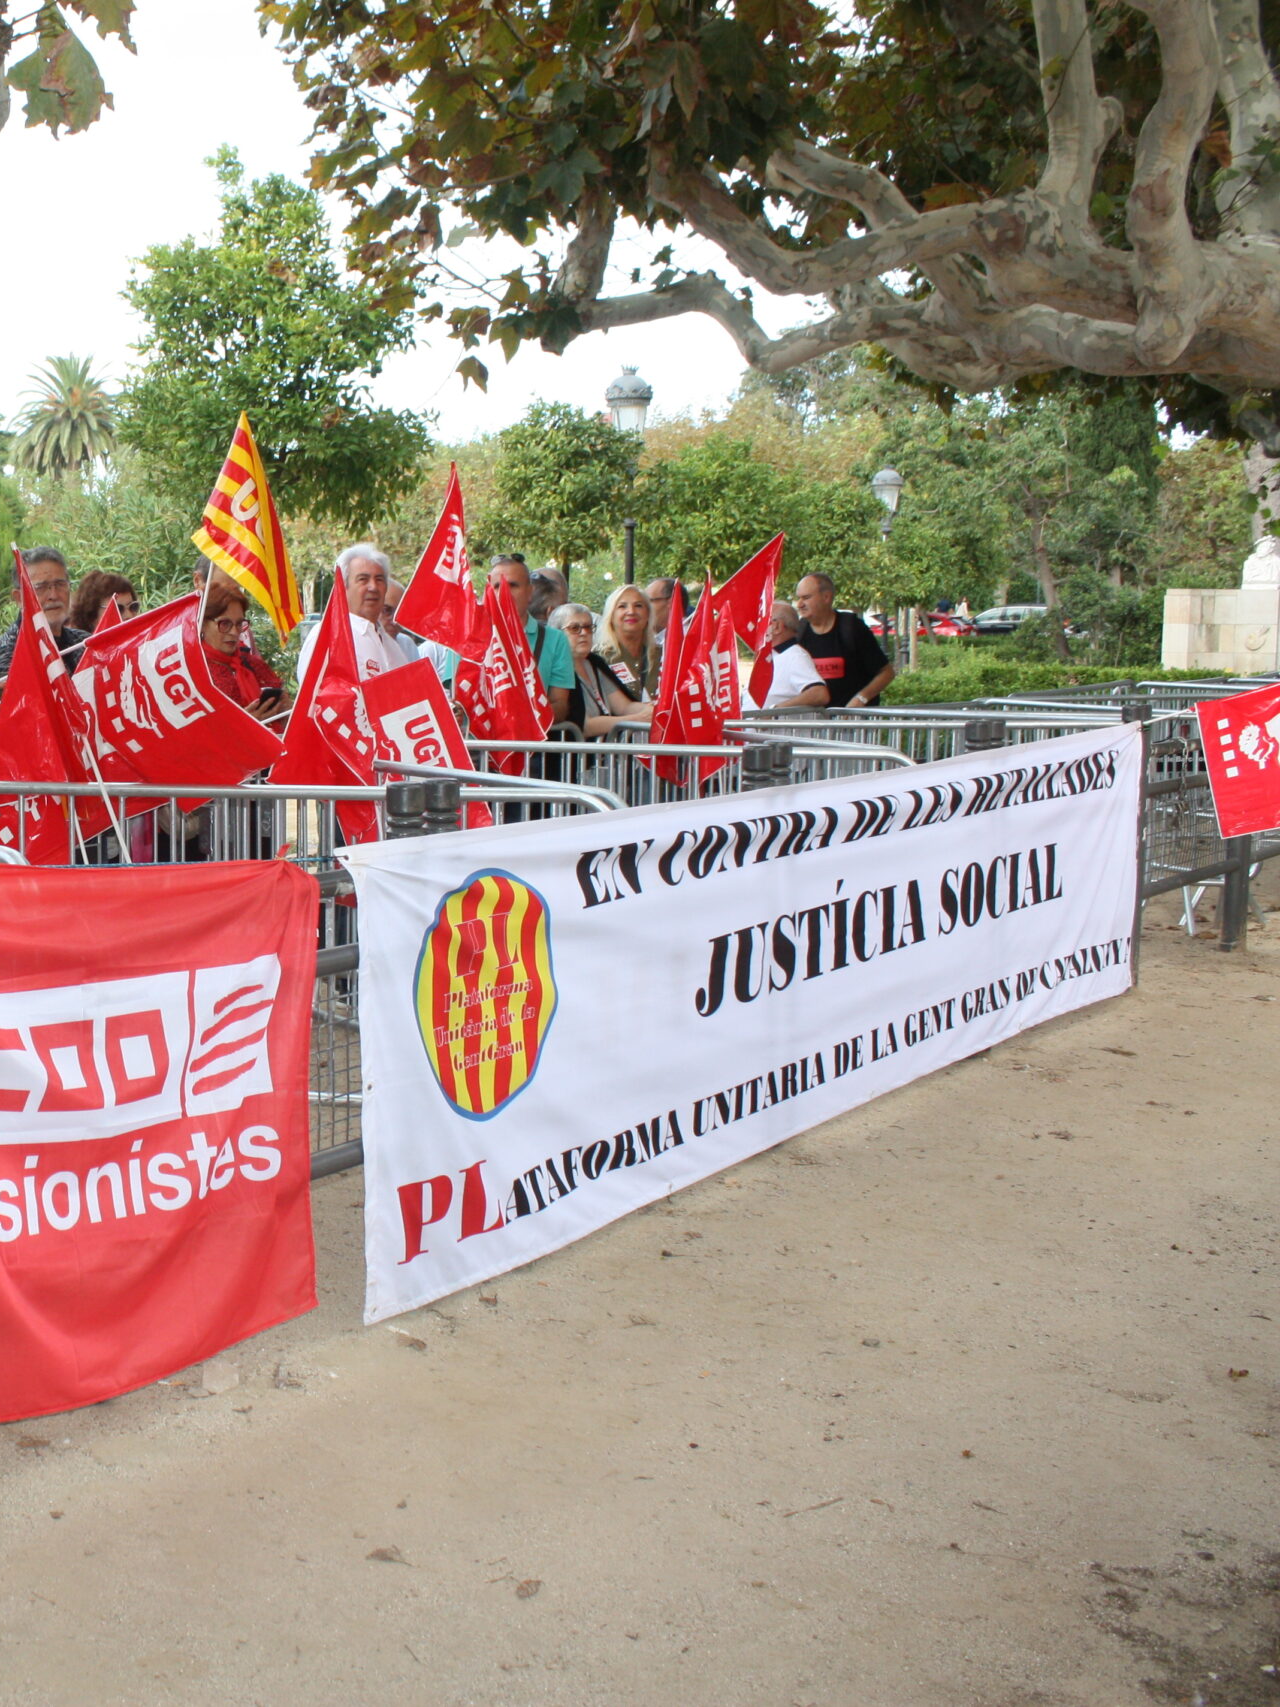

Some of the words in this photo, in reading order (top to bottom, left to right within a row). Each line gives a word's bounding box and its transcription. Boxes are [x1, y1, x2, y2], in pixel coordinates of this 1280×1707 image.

[154, 643, 208, 719] UGT
[576, 838, 655, 909] EN
[658, 806, 839, 886] CONTRA
[841, 794, 902, 844] DE
[899, 781, 966, 832] LES
[961, 749, 1120, 818] RETALLADES
[695, 878, 927, 1018] JUSTÍCIA
[937, 842, 1063, 937] SOCIAL
[443, 978, 534, 1013] Plataforma
[500, 1006, 515, 1028] de
[521, 1003, 536, 1021] la
[397, 1109, 685, 1266] PLATAFORMA
[692, 1051, 826, 1137] UNITARIA
[832, 1034, 864, 1080] DE
[870, 1022, 899, 1063] LA
[903, 997, 956, 1048] GENT
[960, 976, 1011, 1024] GRAN
[1015, 966, 1039, 1002] DE
